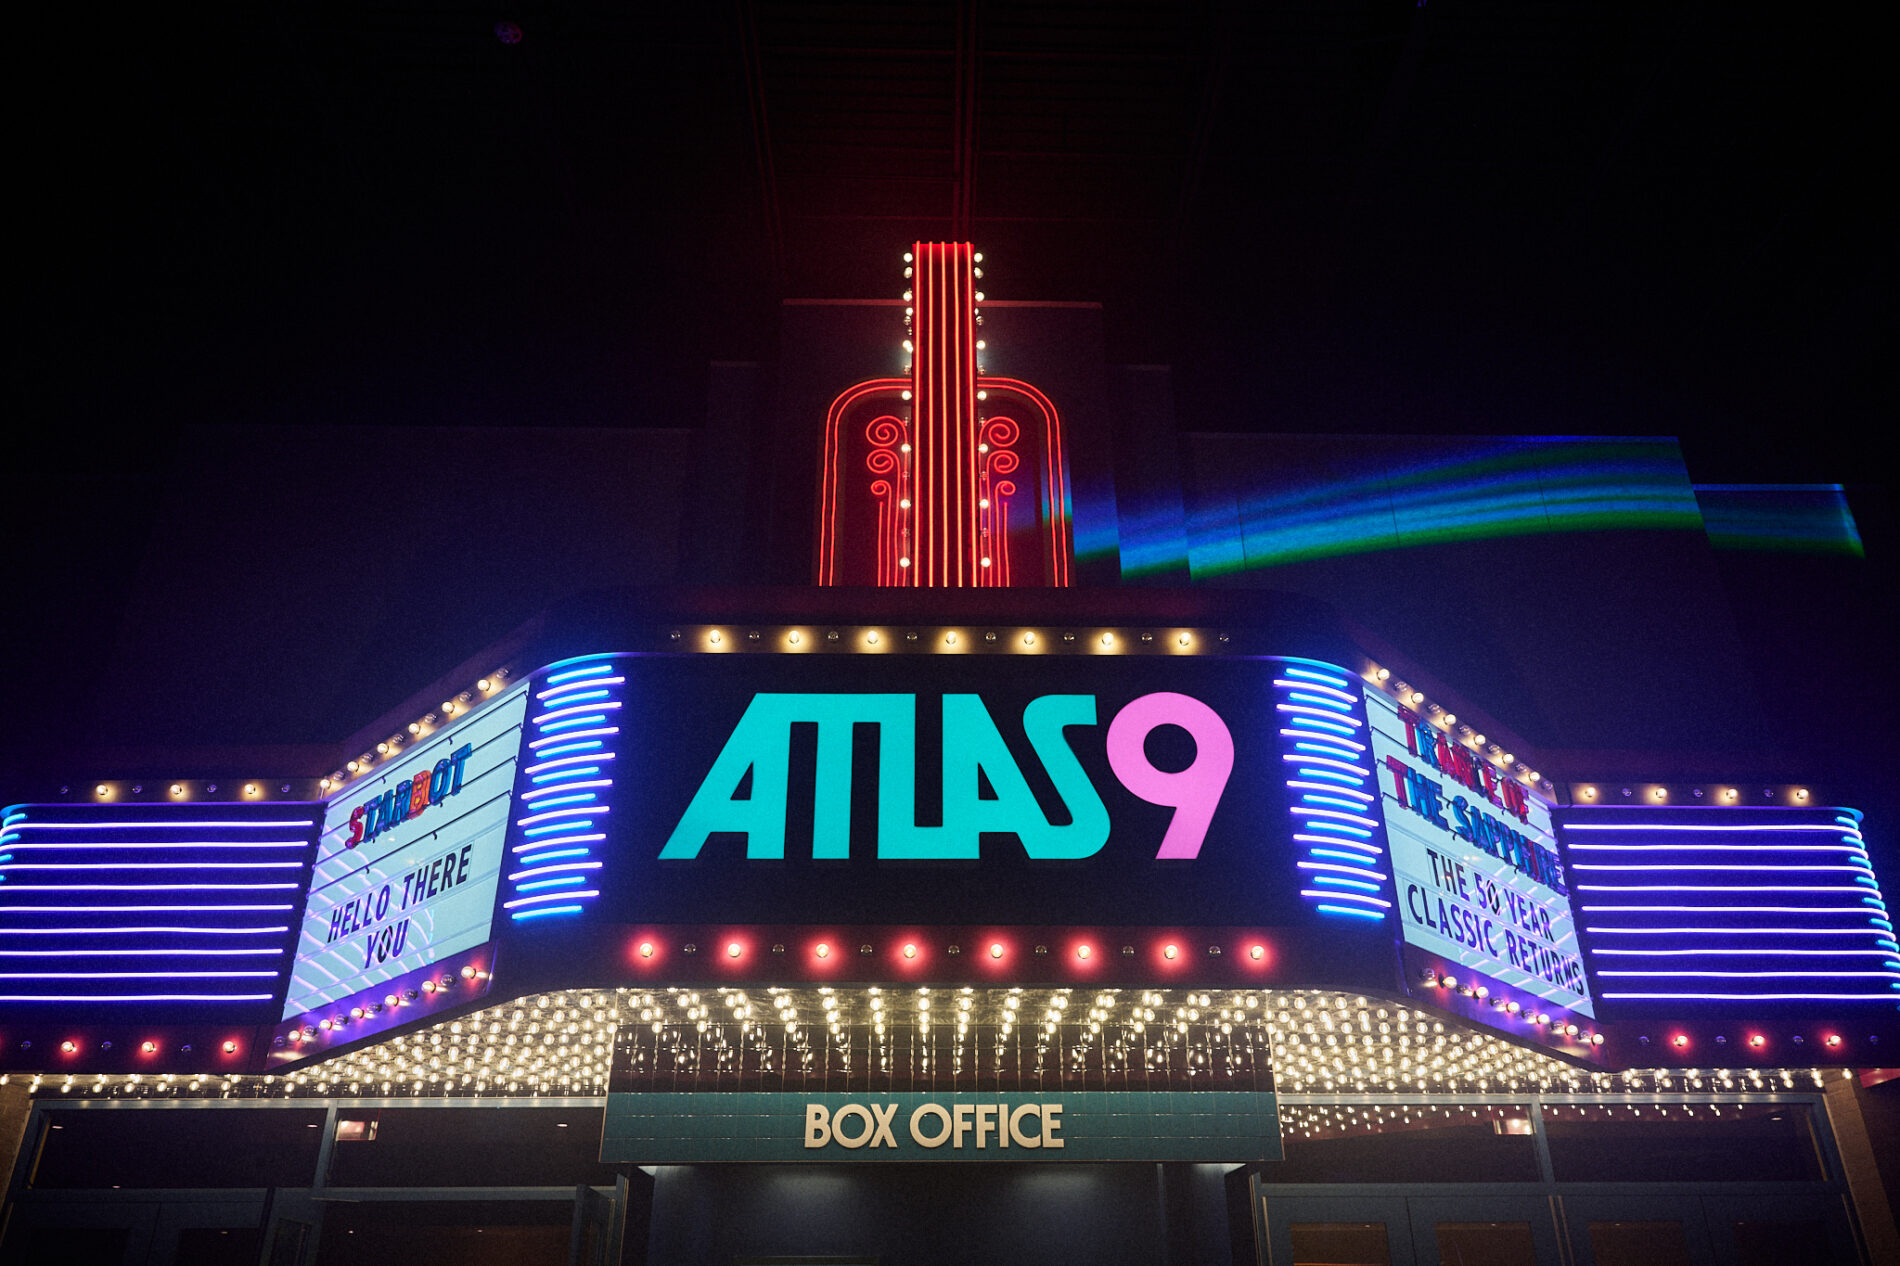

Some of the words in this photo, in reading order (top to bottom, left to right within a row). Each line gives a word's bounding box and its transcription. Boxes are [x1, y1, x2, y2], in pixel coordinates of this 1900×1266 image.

[345, 743, 472, 849] STARBOT
[1397, 702, 1504, 810] TRANCE
[1386, 754, 1450, 832] THE
[1452, 794, 1570, 898] SAPPHIRE
[327, 885, 391, 943] HELLO
[401, 844, 472, 911] THERE
[364, 918, 411, 969] YOU
[1407, 884, 1498, 958] CLASSIC
[1505, 929, 1585, 996] RETURNS
[1427, 847, 1470, 901] THE
[1474, 872, 1500, 916] 50
[1504, 888, 1555, 943] YEAR
[804, 1103, 899, 1149] BOX
[909, 1103, 1065, 1149] OFFICE
